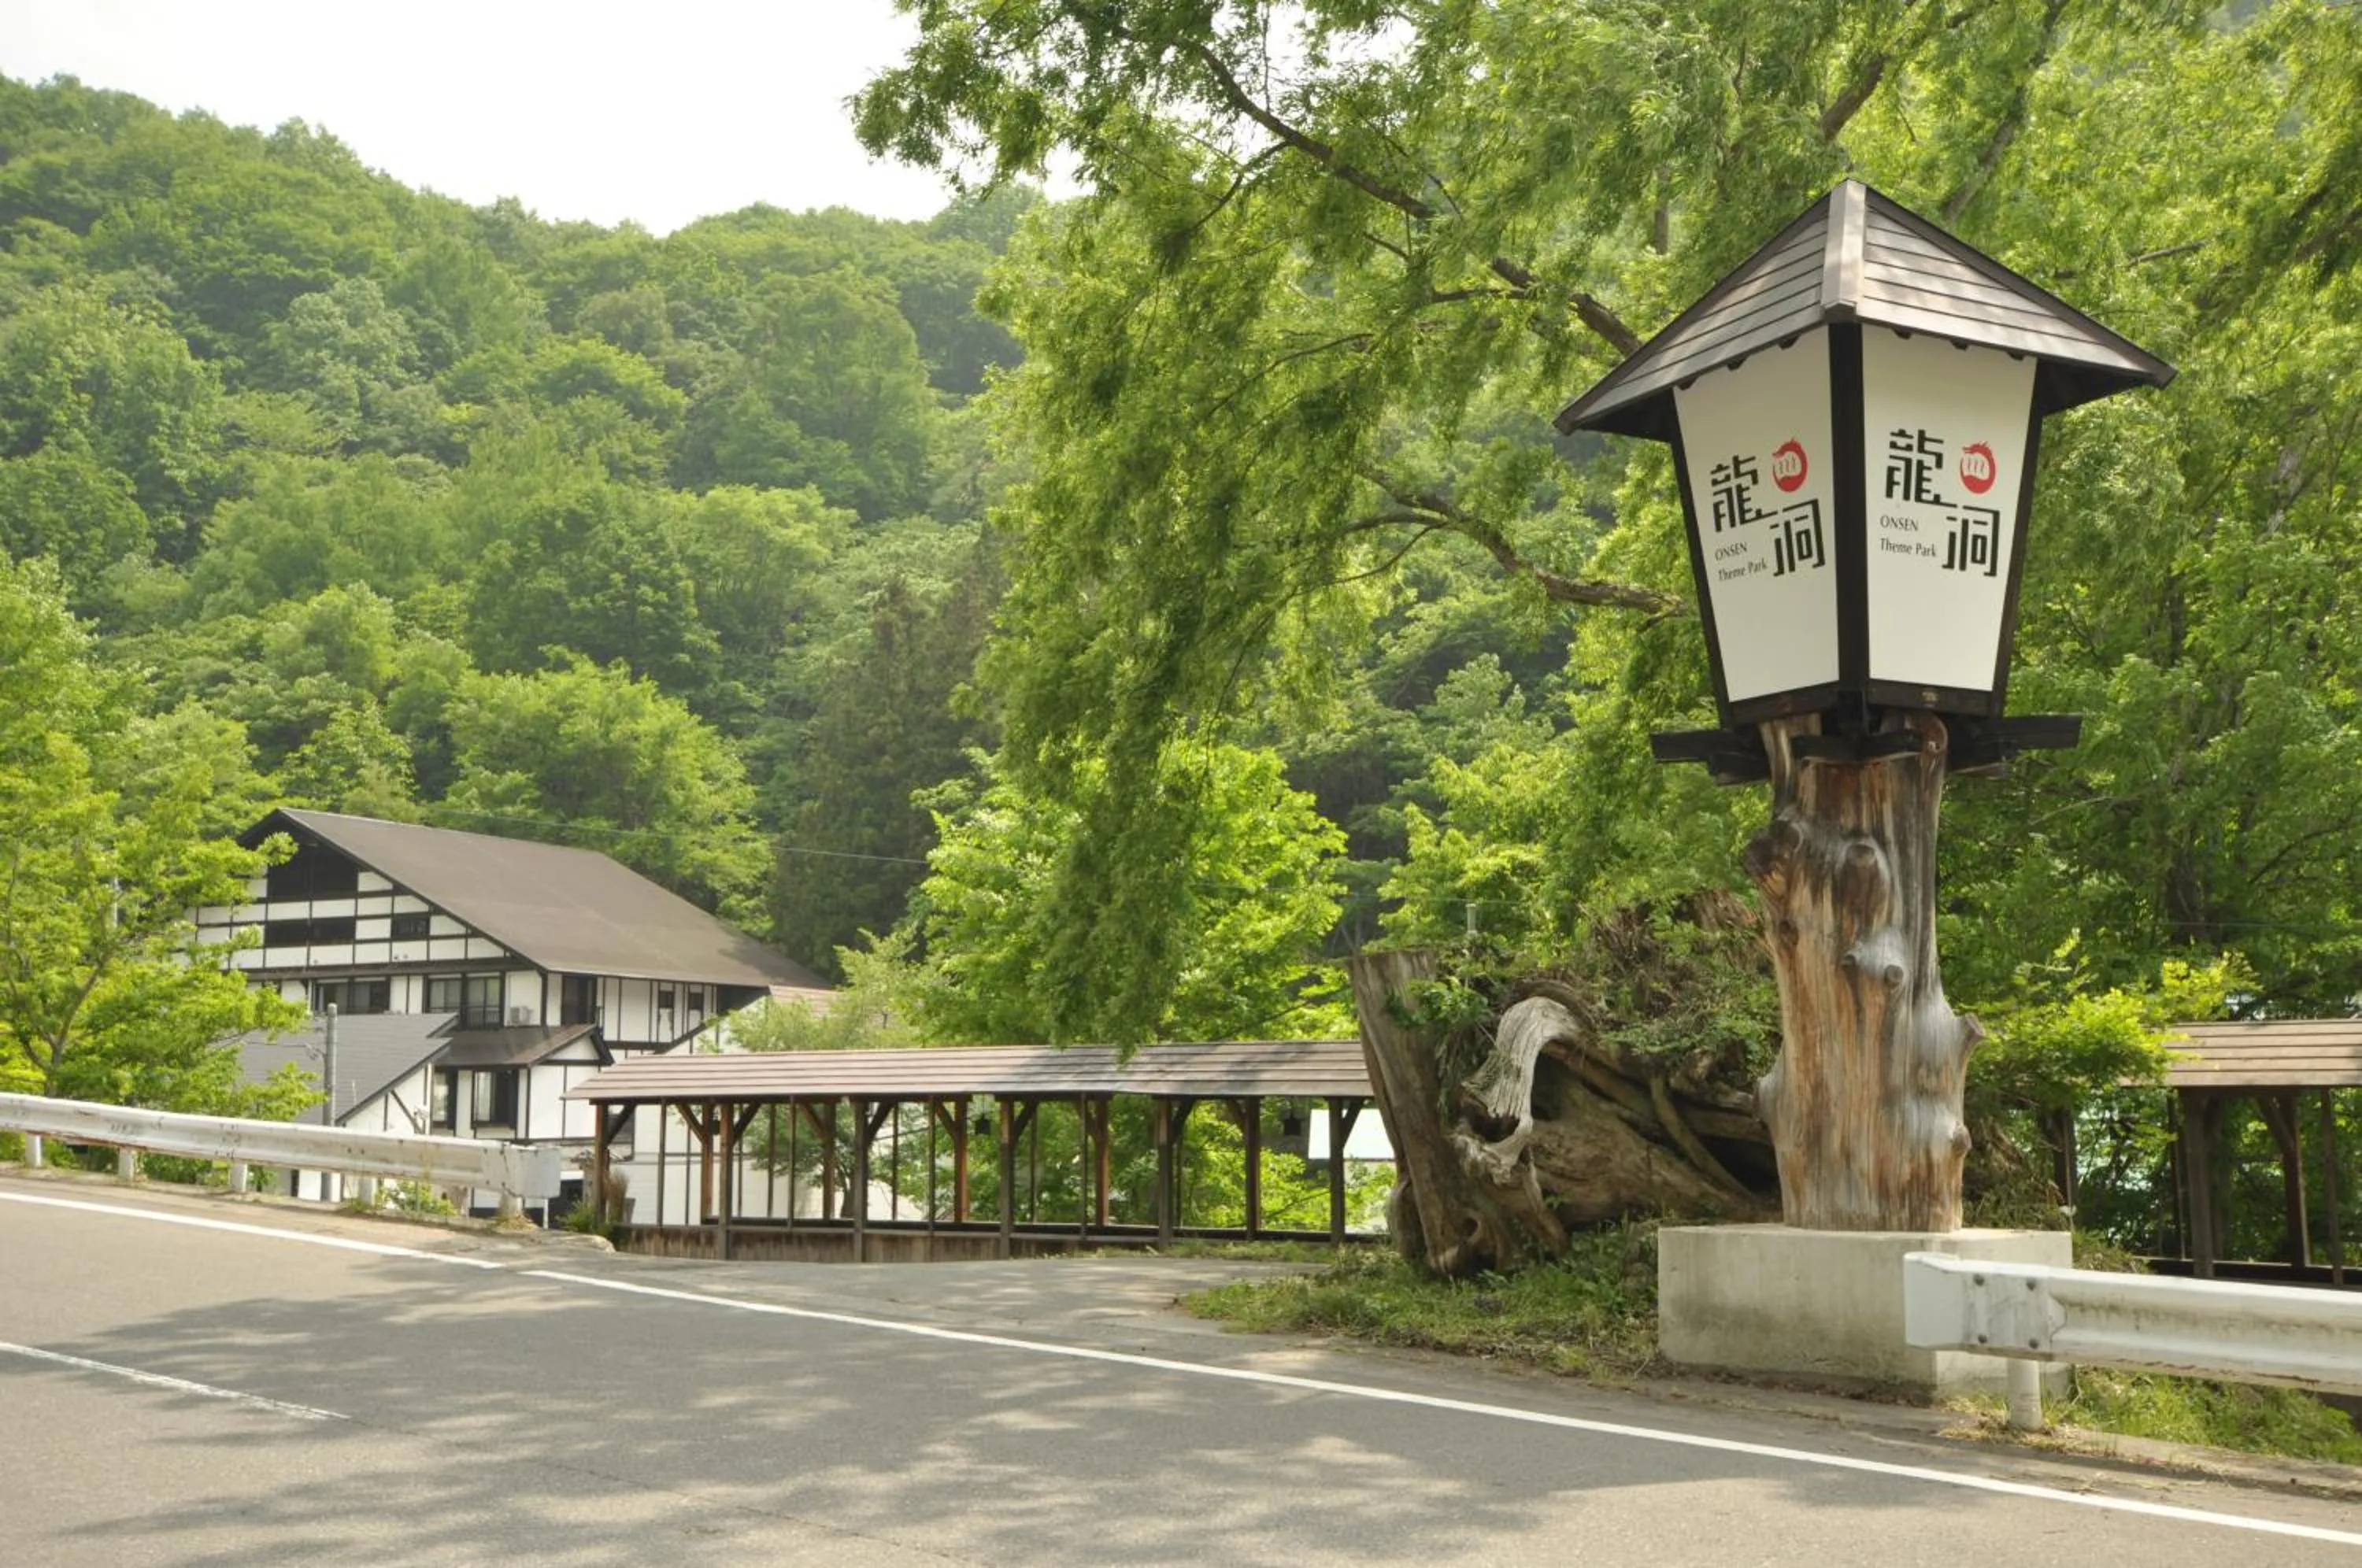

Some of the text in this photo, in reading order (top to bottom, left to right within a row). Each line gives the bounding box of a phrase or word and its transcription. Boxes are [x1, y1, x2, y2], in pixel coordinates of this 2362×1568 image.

[1879, 514, 1919, 531] ONSEN
[1715, 542, 1748, 561] ONSEN
[1880, 538, 1937, 557] Theme Park
[1718, 558, 1768, 581] Theme Park
